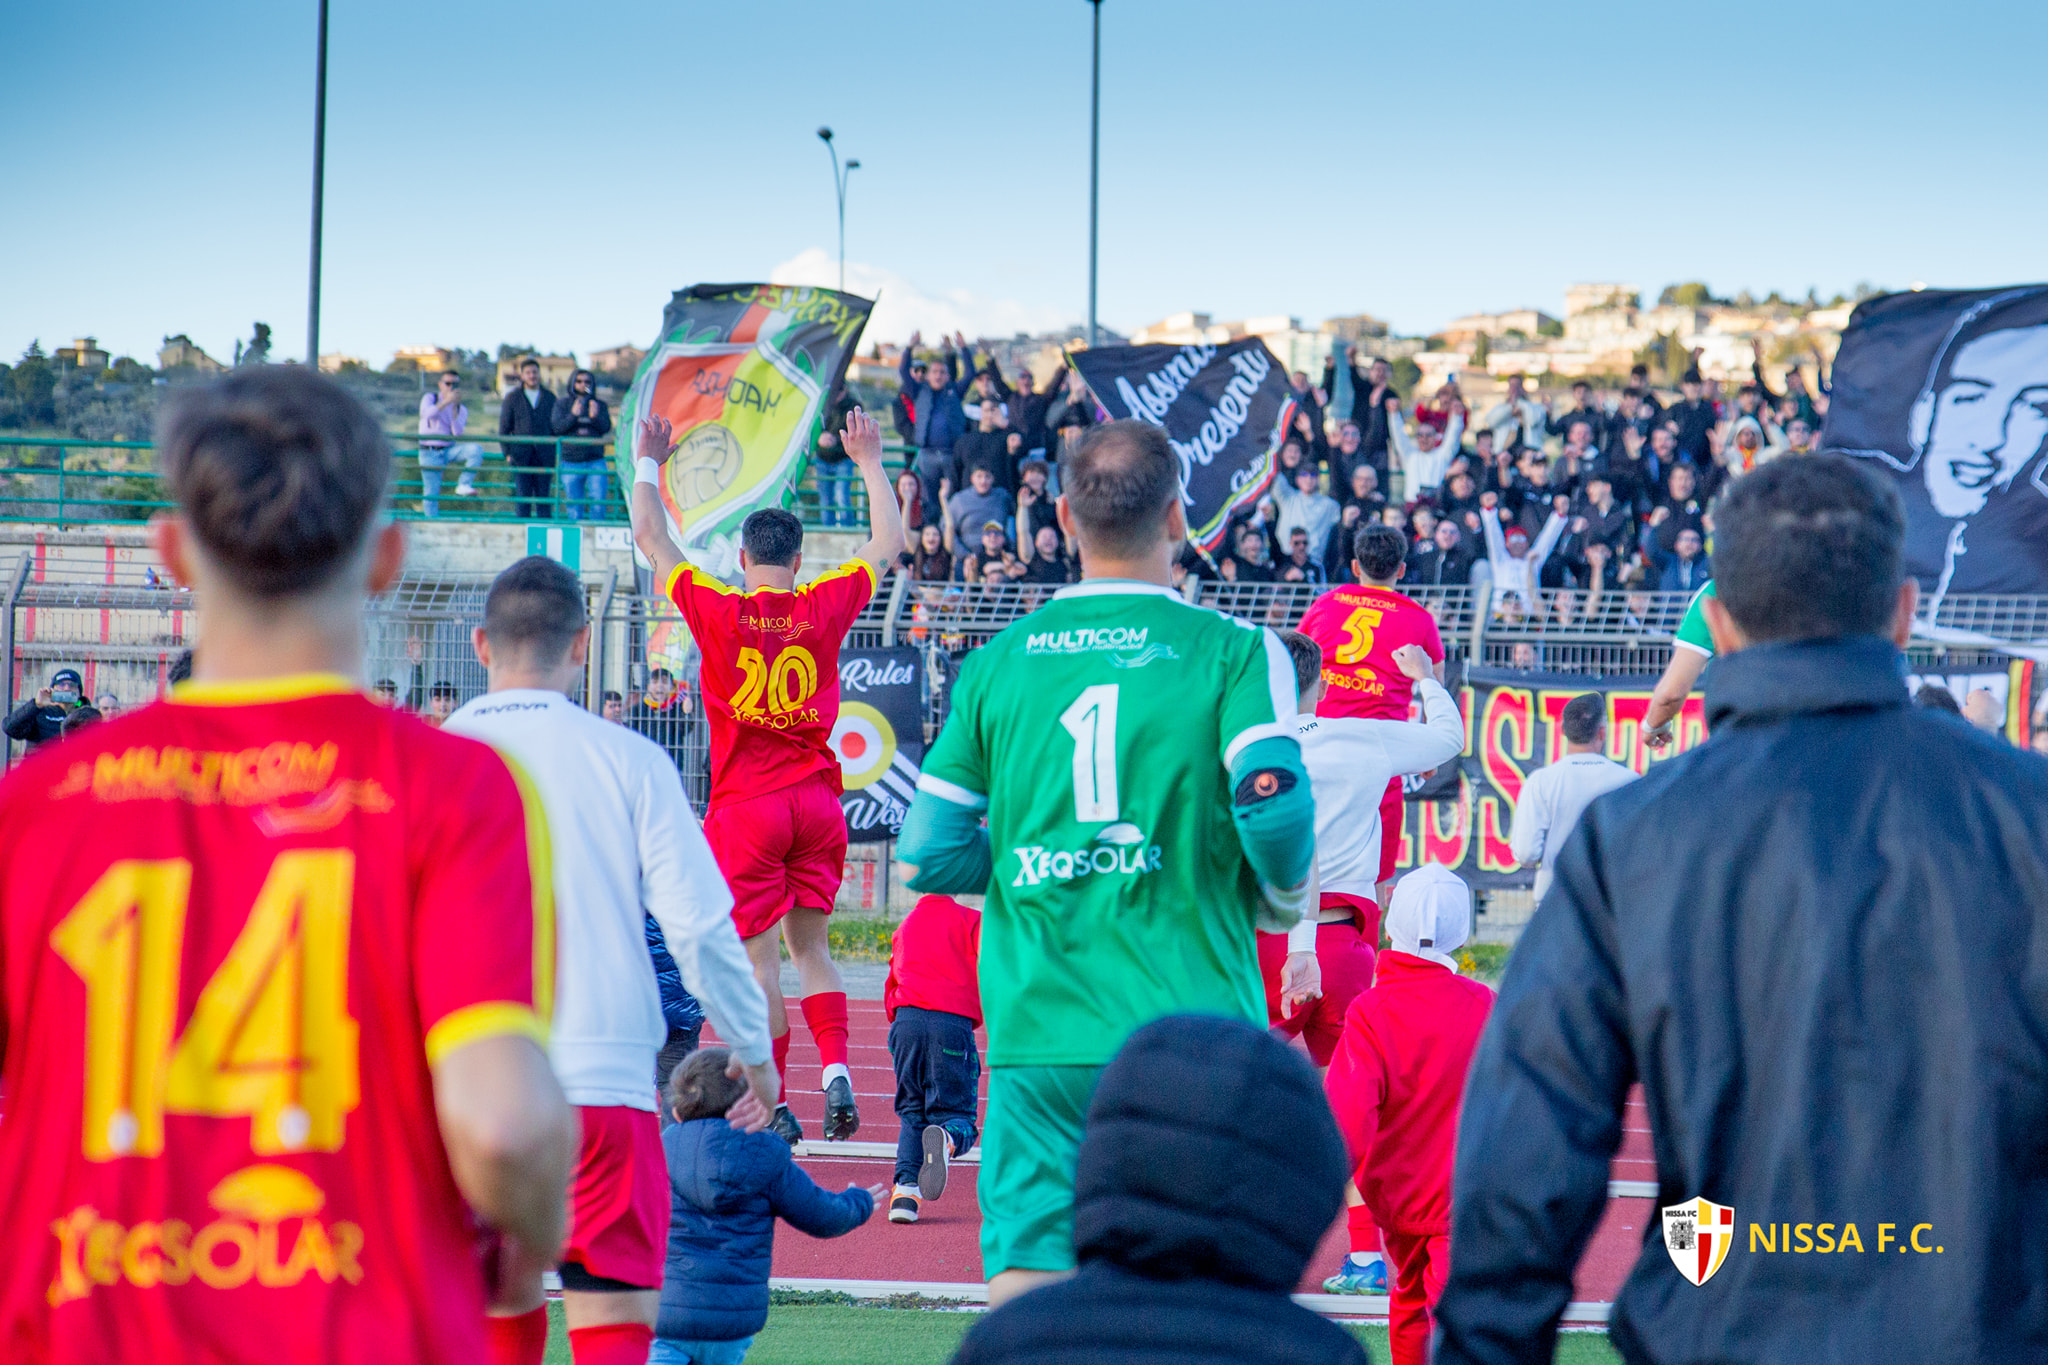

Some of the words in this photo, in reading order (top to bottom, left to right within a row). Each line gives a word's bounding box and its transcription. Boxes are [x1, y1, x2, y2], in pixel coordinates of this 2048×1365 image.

[1339, 593, 1396, 610] MULTICOM
[1026, 627, 1149, 650] MULTICOM
[1335, 607, 1383, 664] 5
[728, 645, 818, 715] 20
[840, 658, 915, 692] Rules
[1059, 683, 1120, 823] 1
[1012, 845, 1163, 887] XEQSOLAR
[50, 847, 360, 1163] 14
